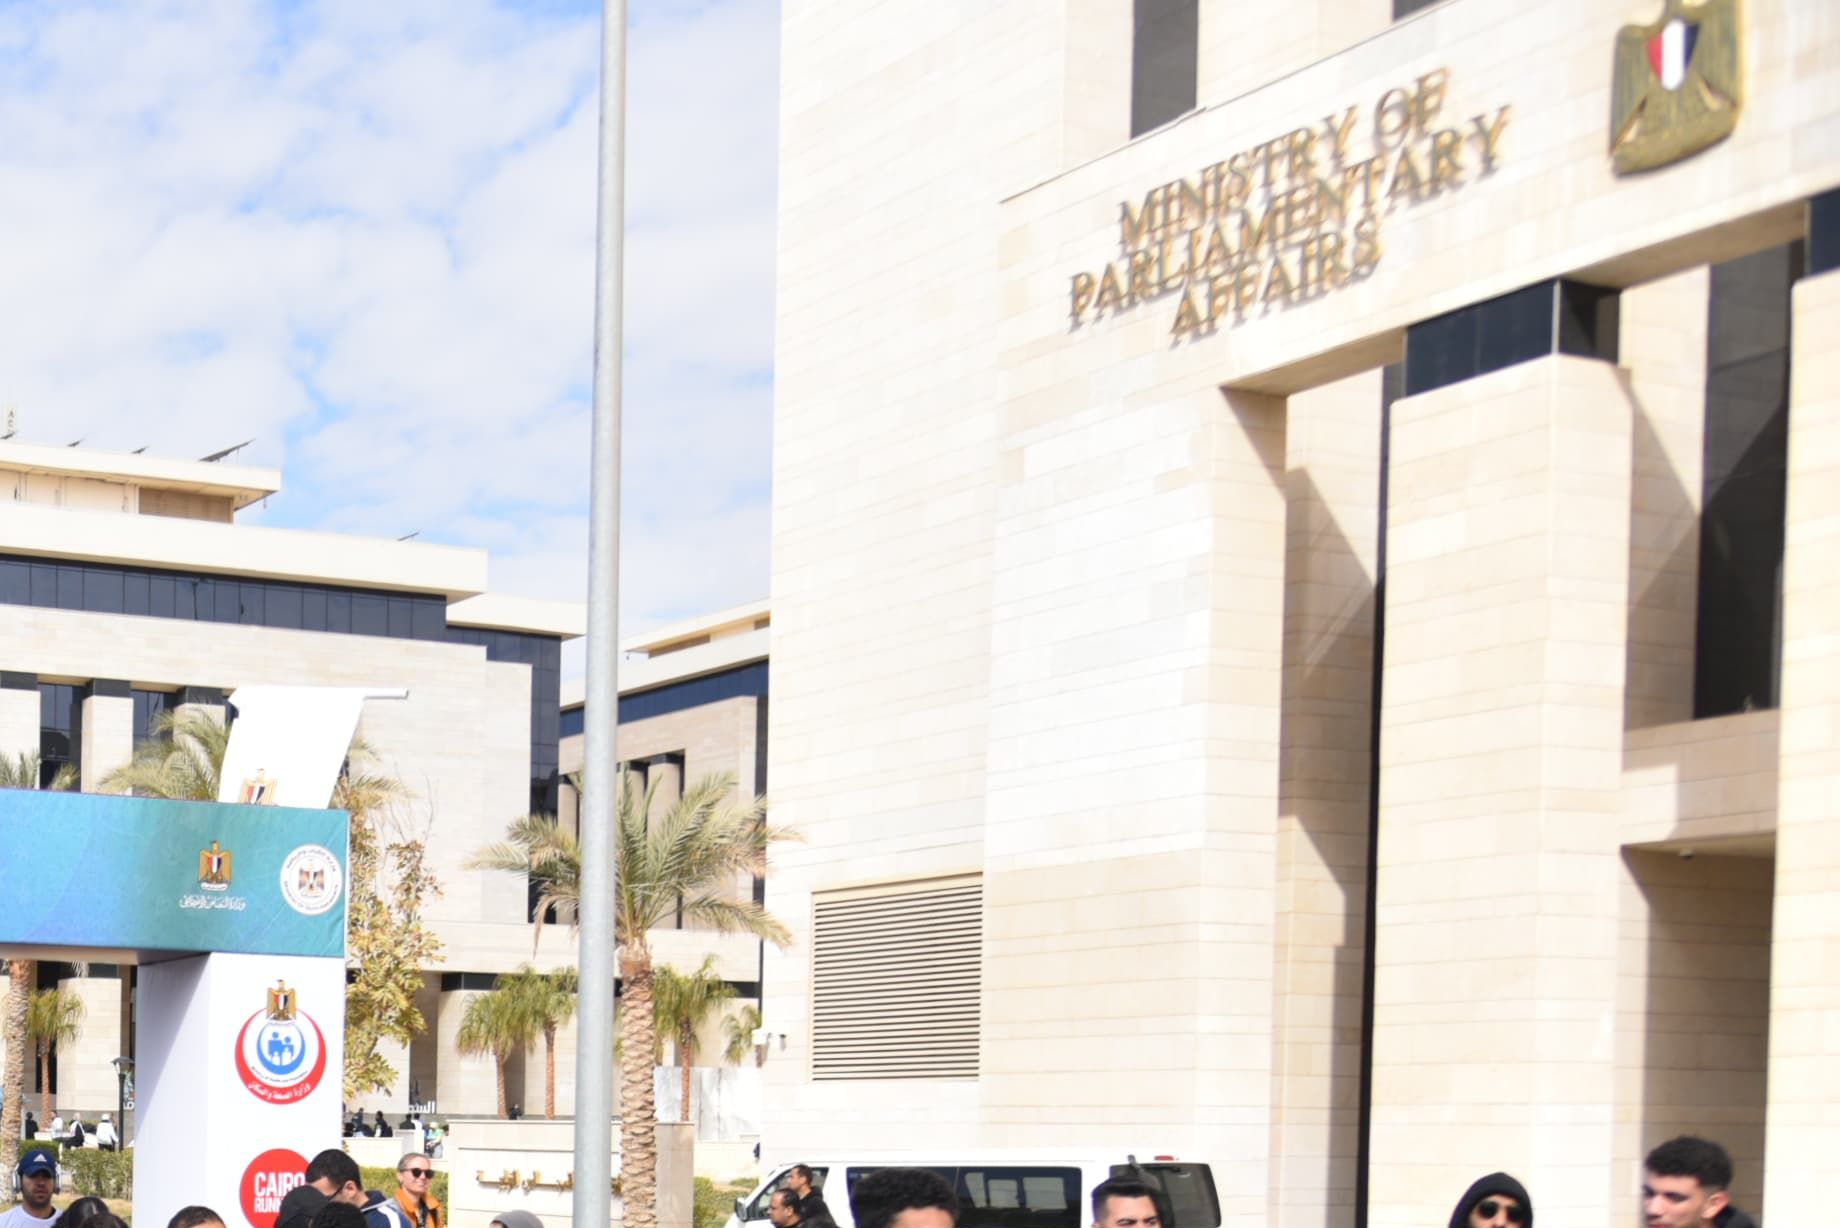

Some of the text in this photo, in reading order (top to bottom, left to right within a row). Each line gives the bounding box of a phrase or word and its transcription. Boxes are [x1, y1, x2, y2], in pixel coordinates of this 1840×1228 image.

[1070, 104, 1512, 330] PARLIAMENTARY
[1119, 66, 1450, 249] MINISTRY OF
[1168, 214, 1383, 346] AFFAIRS
